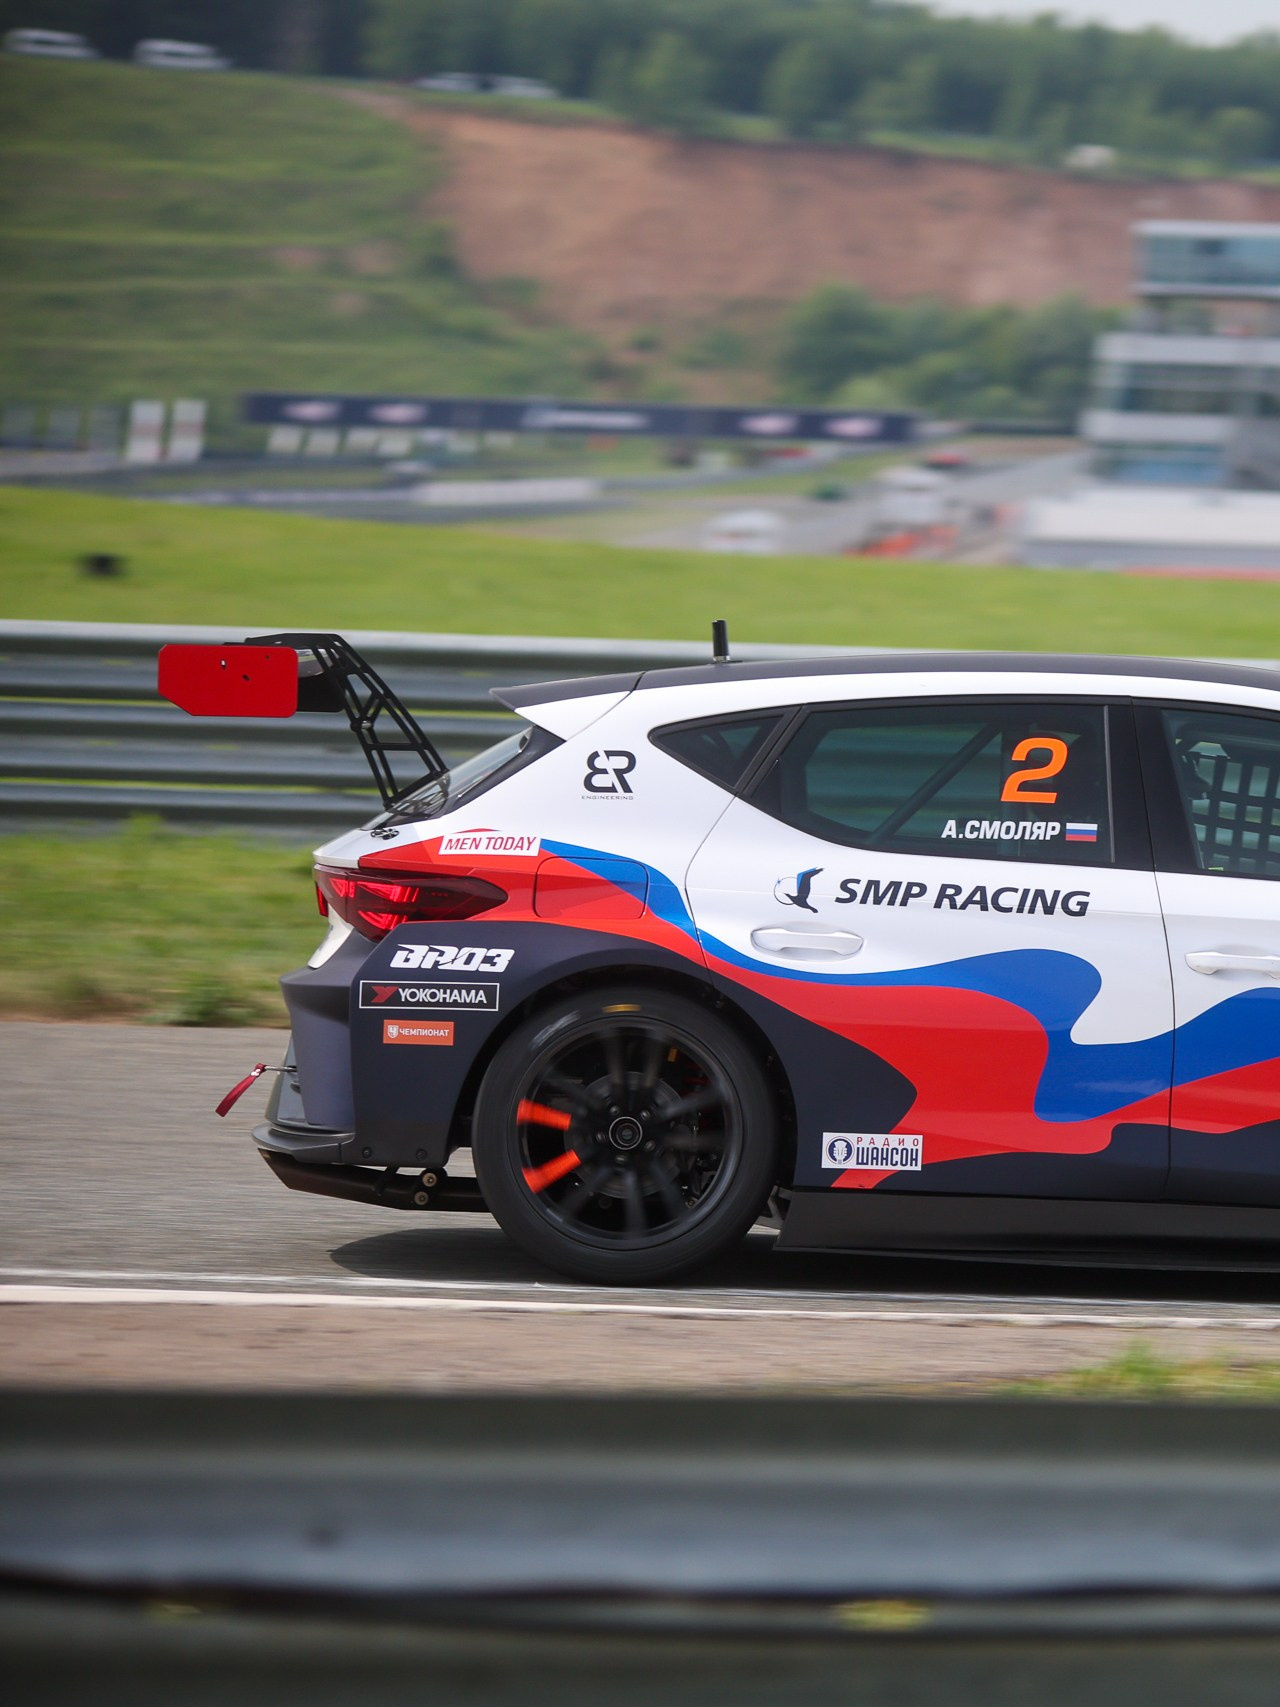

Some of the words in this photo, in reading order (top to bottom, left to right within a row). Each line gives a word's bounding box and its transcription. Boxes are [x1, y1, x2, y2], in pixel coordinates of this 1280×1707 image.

[1000, 737, 1069, 804] 2
[941, 820, 1061, 841] А.СМОЛЯР
[444, 837, 482, 851] MEN
[485, 836, 537, 851] TODAY
[834, 878, 928, 907] SMP
[933, 884, 1091, 917] RACING
[398, 988, 487, 1004] YOKOHAMA
[400, 1028, 449, 1037] ЧЕМПИОНАТ
[856, 1136, 919, 1147] РАДИО
[856, 1147, 919, 1167] ШАНСОН
